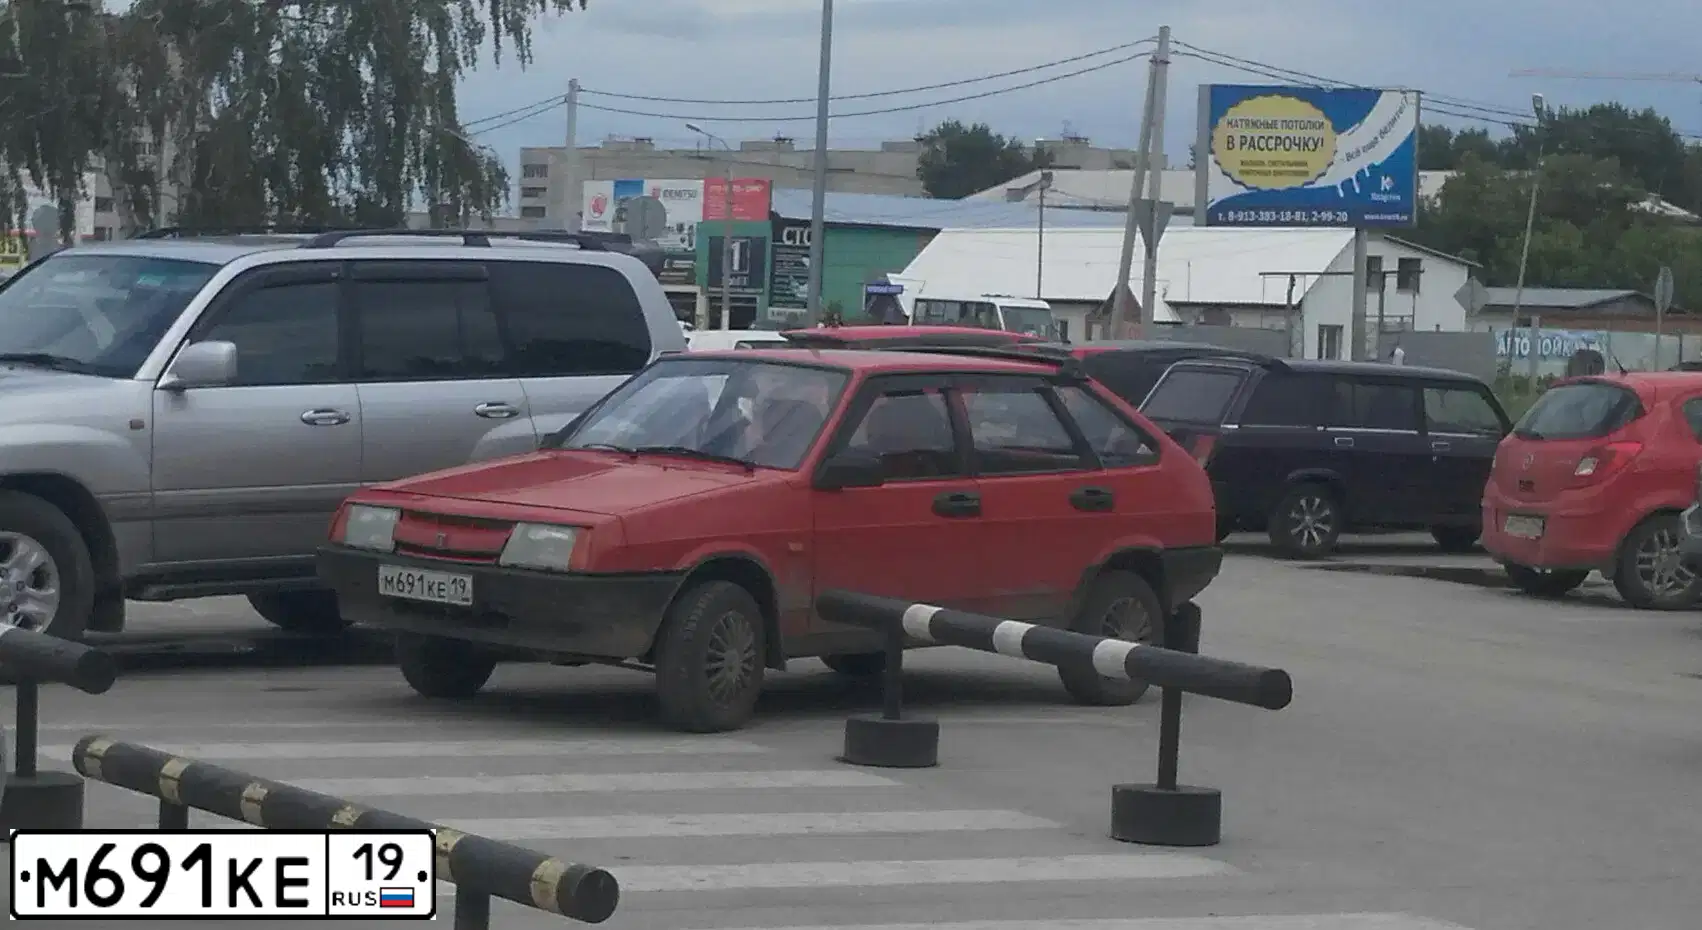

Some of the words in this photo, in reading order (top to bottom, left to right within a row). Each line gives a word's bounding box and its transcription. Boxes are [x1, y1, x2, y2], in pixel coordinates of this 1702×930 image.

[1227, 118, 1278, 129] НАТЯЖНЫЕ
[1281, 119, 1325, 130] ПОТОЛКИ
[1227, 135, 1235, 150] В
[1240, 135, 1324, 152] РАССРОЧКУ!
[1311, 211, 1348, 222] 2-99-20
[1497, 337, 1586, 357] АТООЙК
[451, 577, 466, 596] 19
